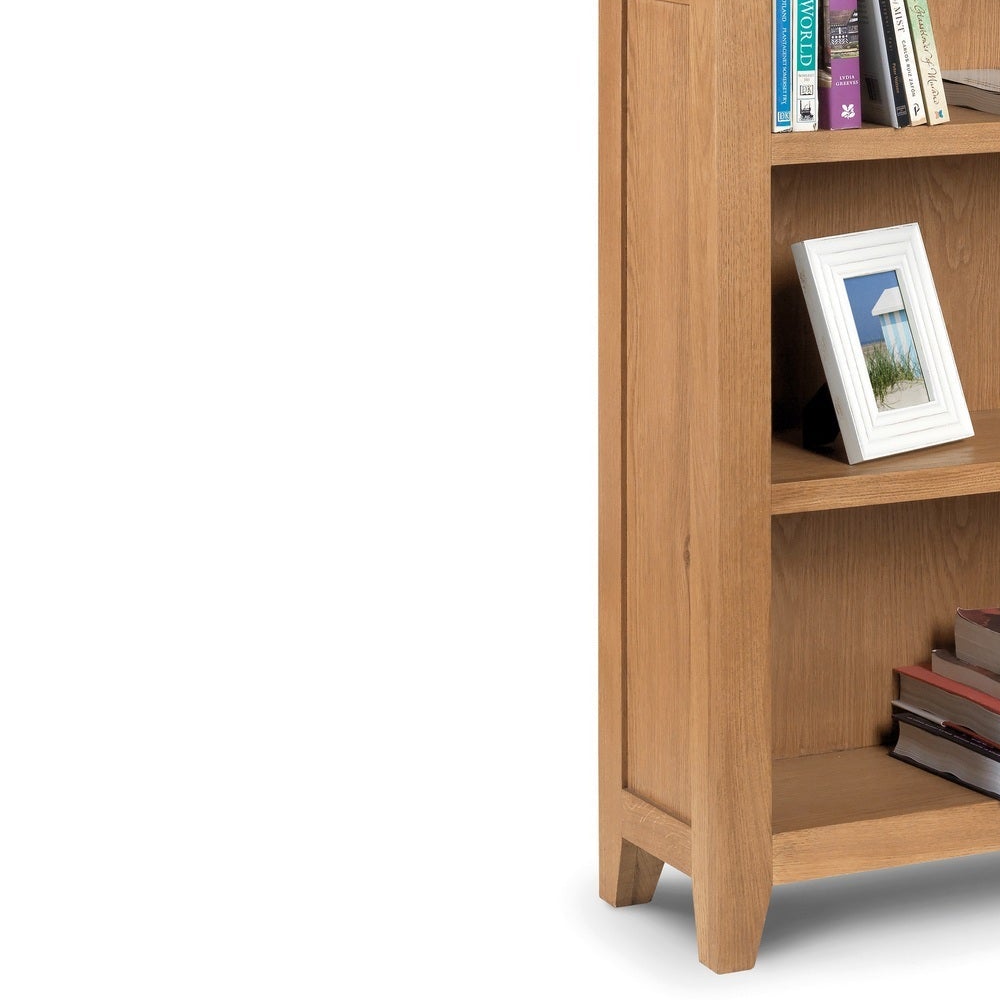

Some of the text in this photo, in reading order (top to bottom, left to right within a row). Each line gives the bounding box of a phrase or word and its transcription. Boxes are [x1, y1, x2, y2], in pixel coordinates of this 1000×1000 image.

[893, 6, 906, 34] MIST
[901, 39, 910, 63] CARLOS
[905, 64, 913, 78] RUIZ
